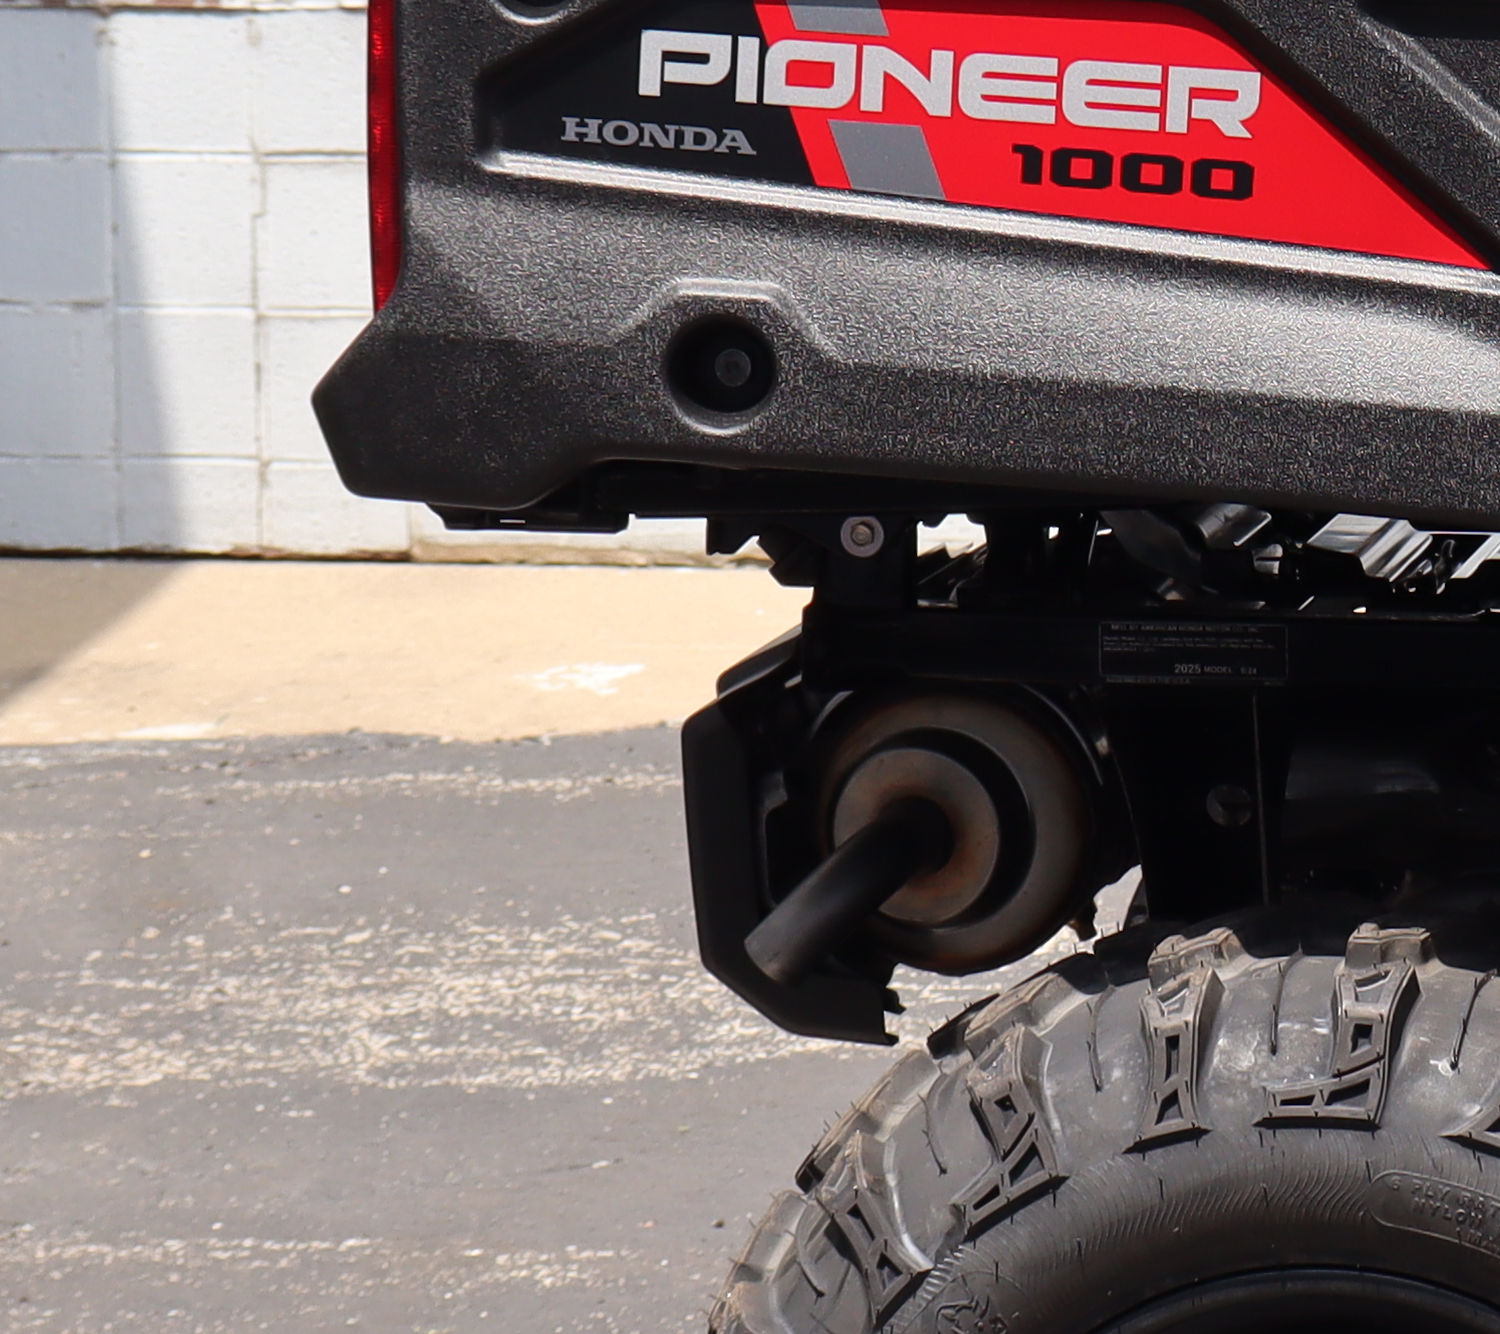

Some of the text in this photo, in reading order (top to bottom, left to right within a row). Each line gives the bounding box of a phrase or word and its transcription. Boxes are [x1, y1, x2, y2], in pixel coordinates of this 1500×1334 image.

[636, 28, 1261, 138] PIONEER
[561, 114, 758, 157] HONDA
[1009, 143, 1255, 200] 1000
[1174, 663, 1202, 675] 2025
[1203, 665, 1233, 675] MODEL
[1409, 1180, 1451, 1203] PLY
[1411, 1196, 1484, 1231] NYLON
